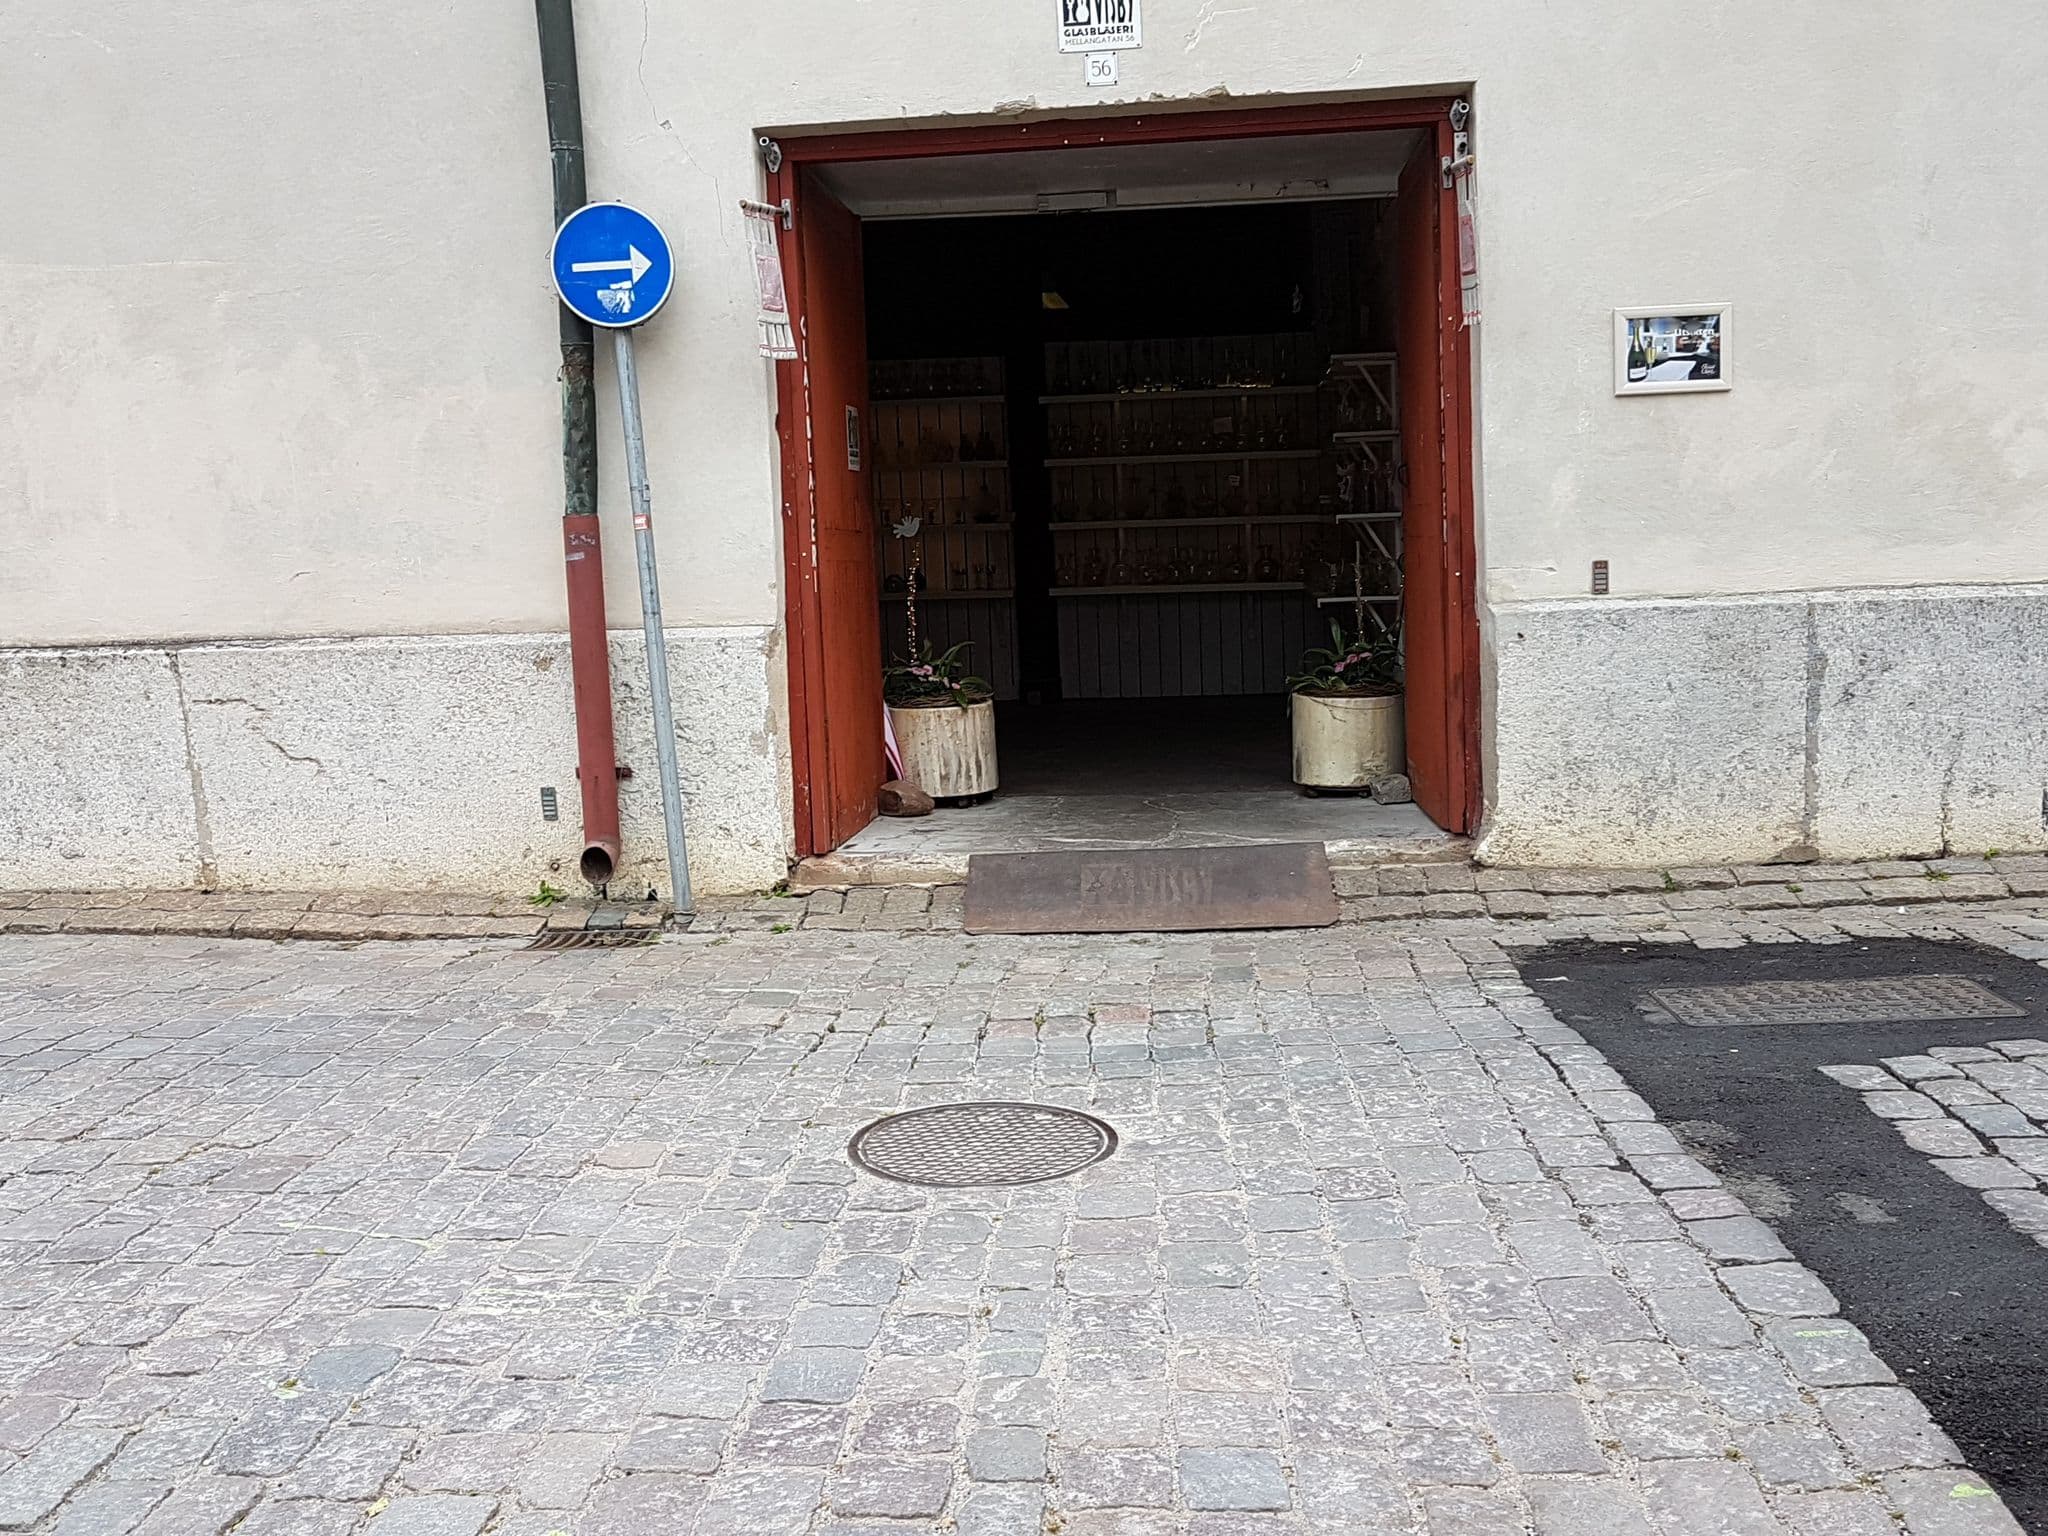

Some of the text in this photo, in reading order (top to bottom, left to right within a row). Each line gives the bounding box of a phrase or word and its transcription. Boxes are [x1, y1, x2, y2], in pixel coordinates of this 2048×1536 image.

[1064, 25, 1134, 37] GLASBLÄSERI
[1065, 35, 1124, 46] MELLANGATAN
[1091, 60, 1112, 77] 56
